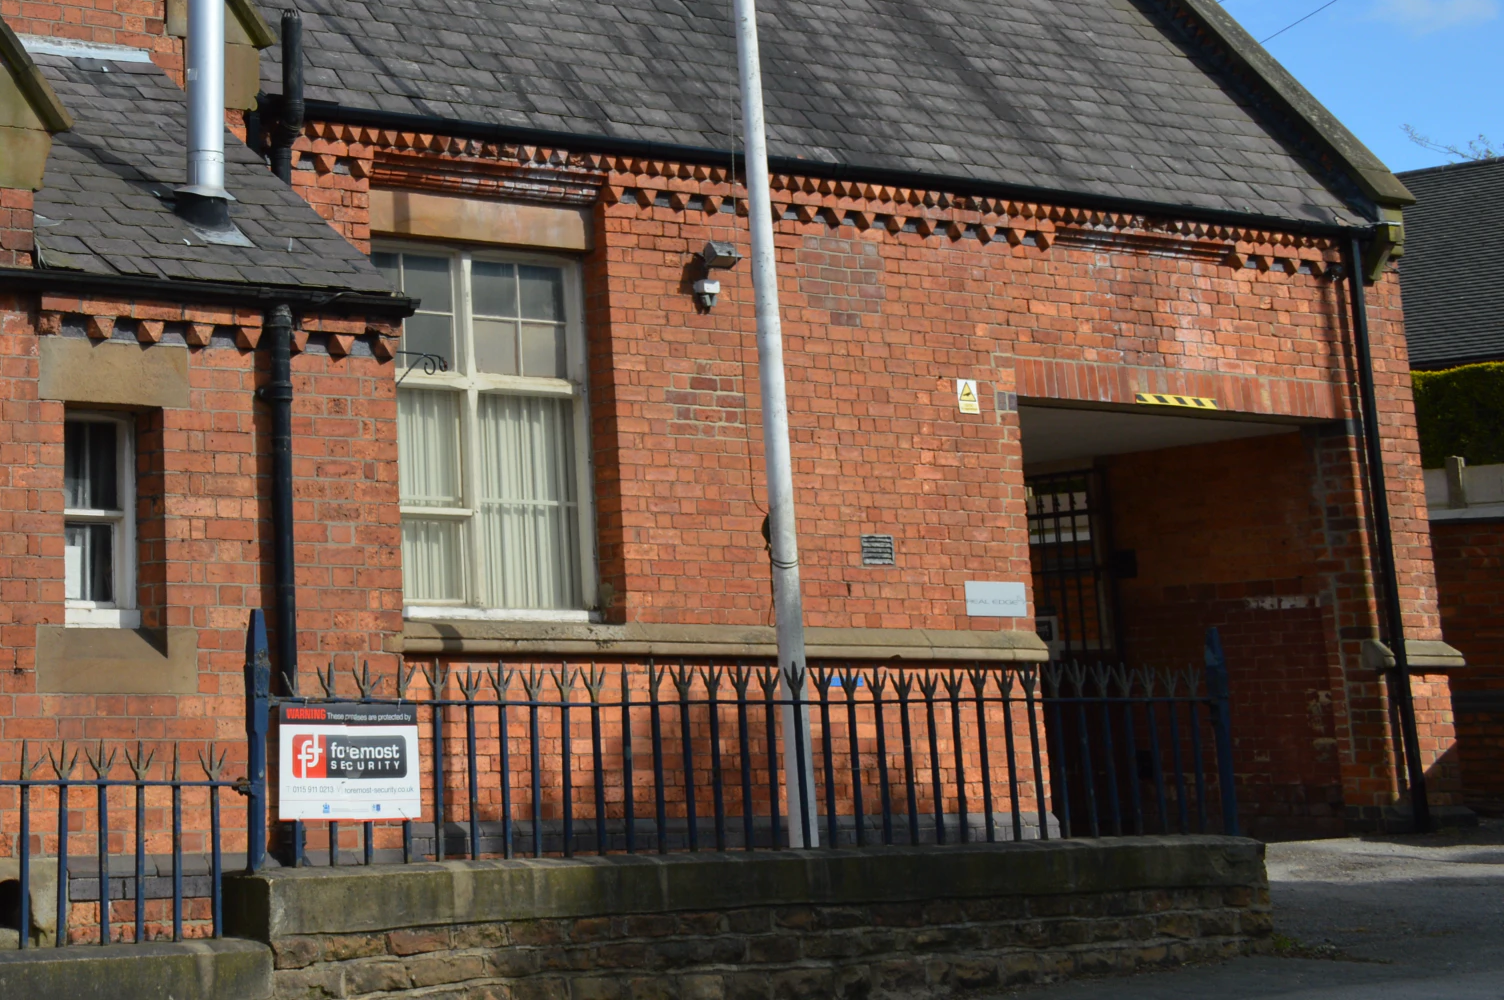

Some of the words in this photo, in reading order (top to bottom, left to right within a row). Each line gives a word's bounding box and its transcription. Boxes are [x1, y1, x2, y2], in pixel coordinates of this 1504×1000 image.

[285, 707, 327, 720] WARNING
[327, 711, 344, 720] These
[377, 713, 403, 722] protected
[404, 713, 412, 722] by
[330, 760, 400, 771] SECURITY
[292, 785, 307, 794] 0115
[307, 785, 318, 794] 911
[319, 785, 334, 794] 0213
